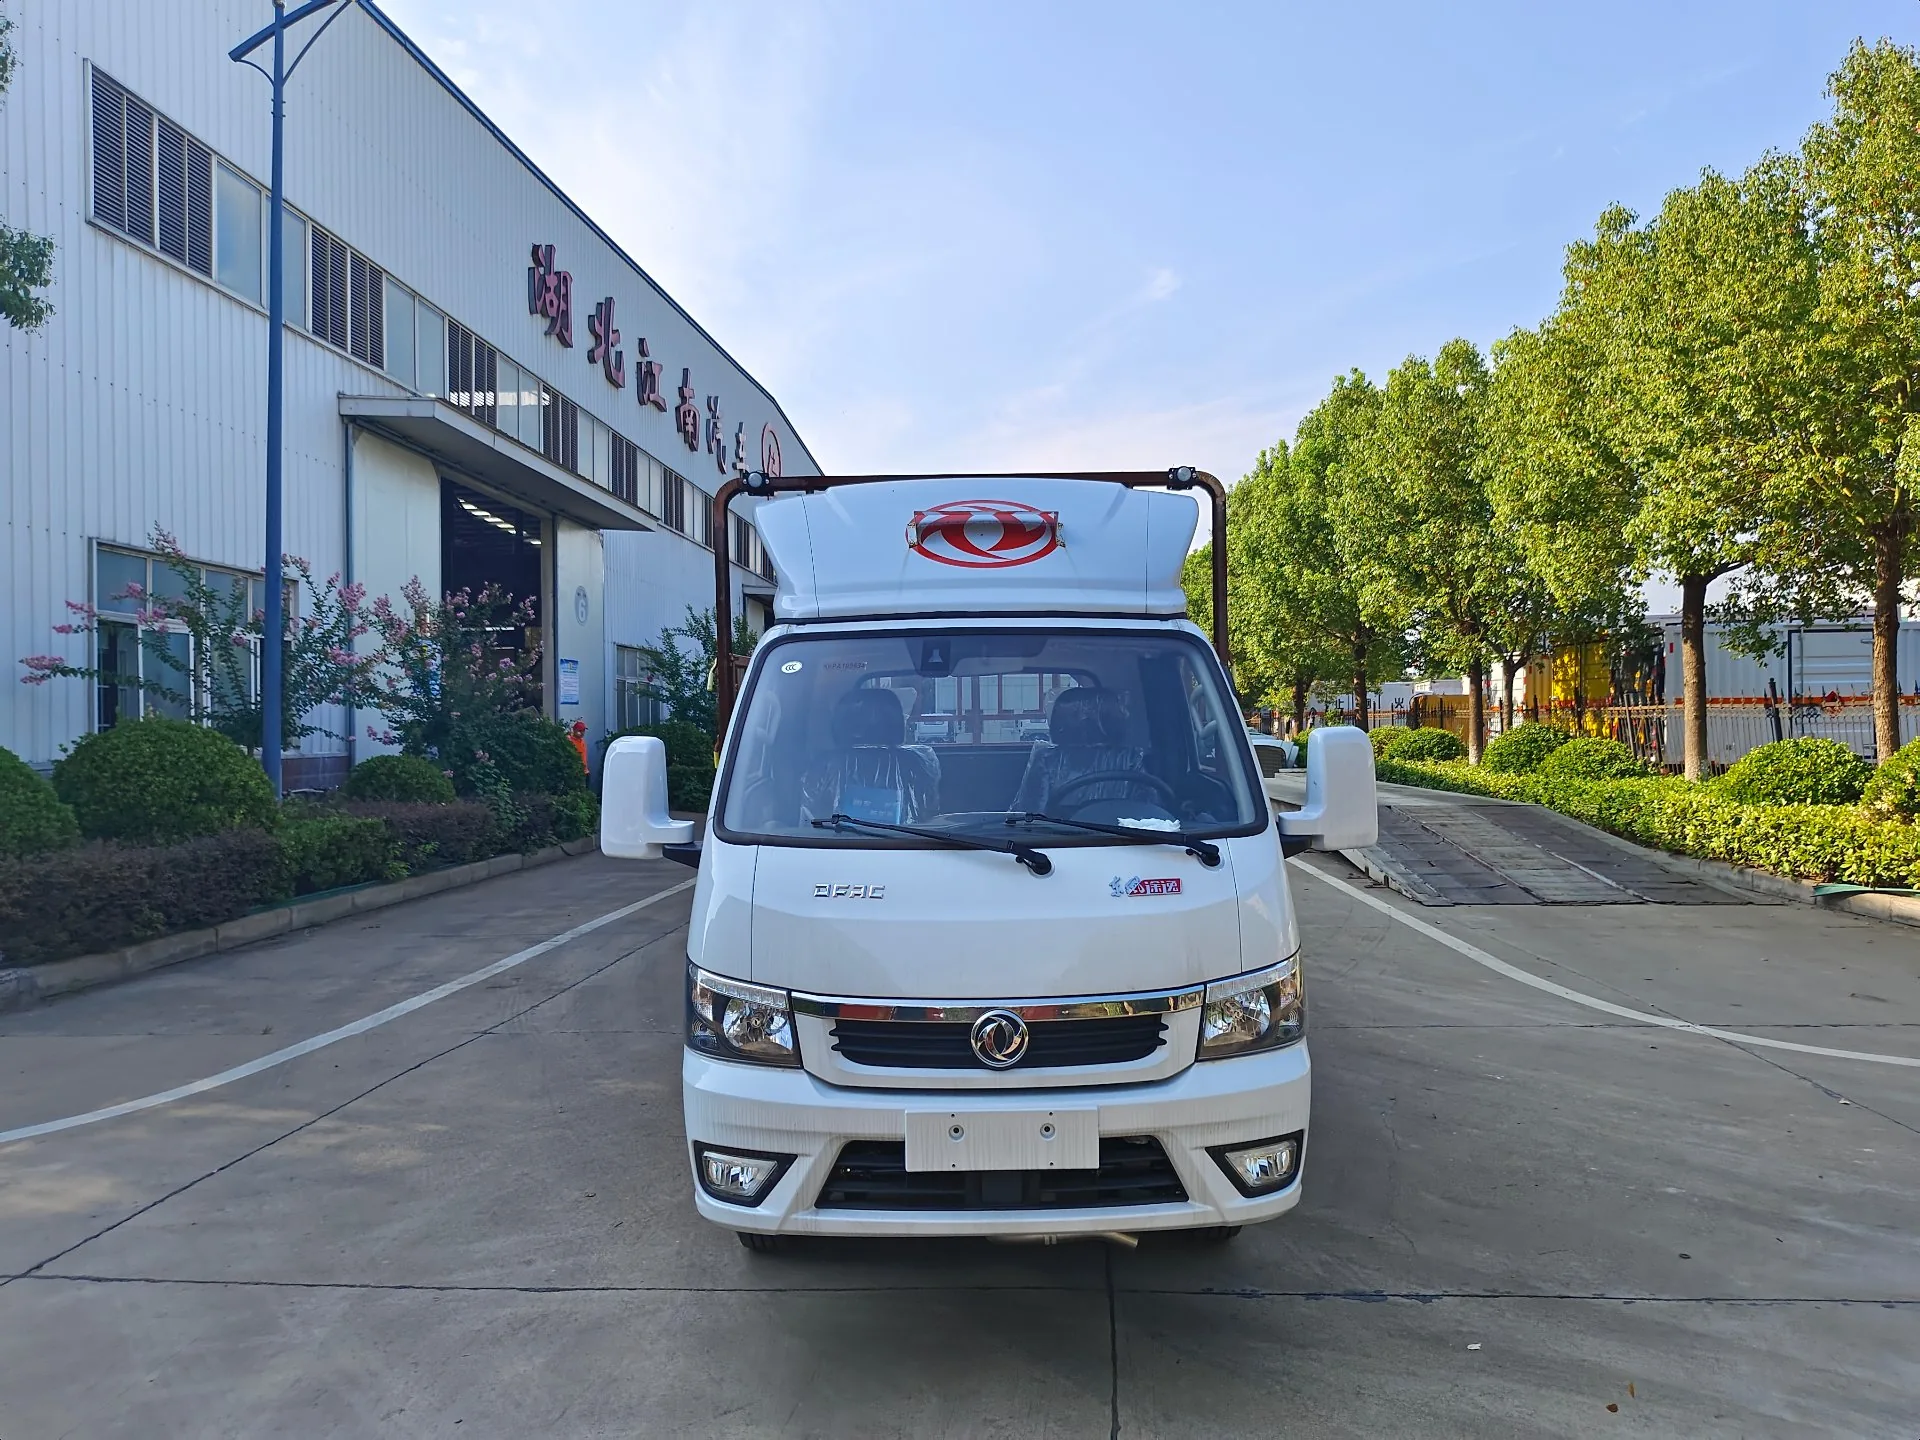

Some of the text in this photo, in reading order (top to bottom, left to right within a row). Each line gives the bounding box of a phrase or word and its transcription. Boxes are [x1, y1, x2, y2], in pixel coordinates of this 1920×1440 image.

[528, 244, 749, 477] 湖北江南汽车
[579, 599, 586, 622] 6
[813, 883, 886, 899] DFAC
